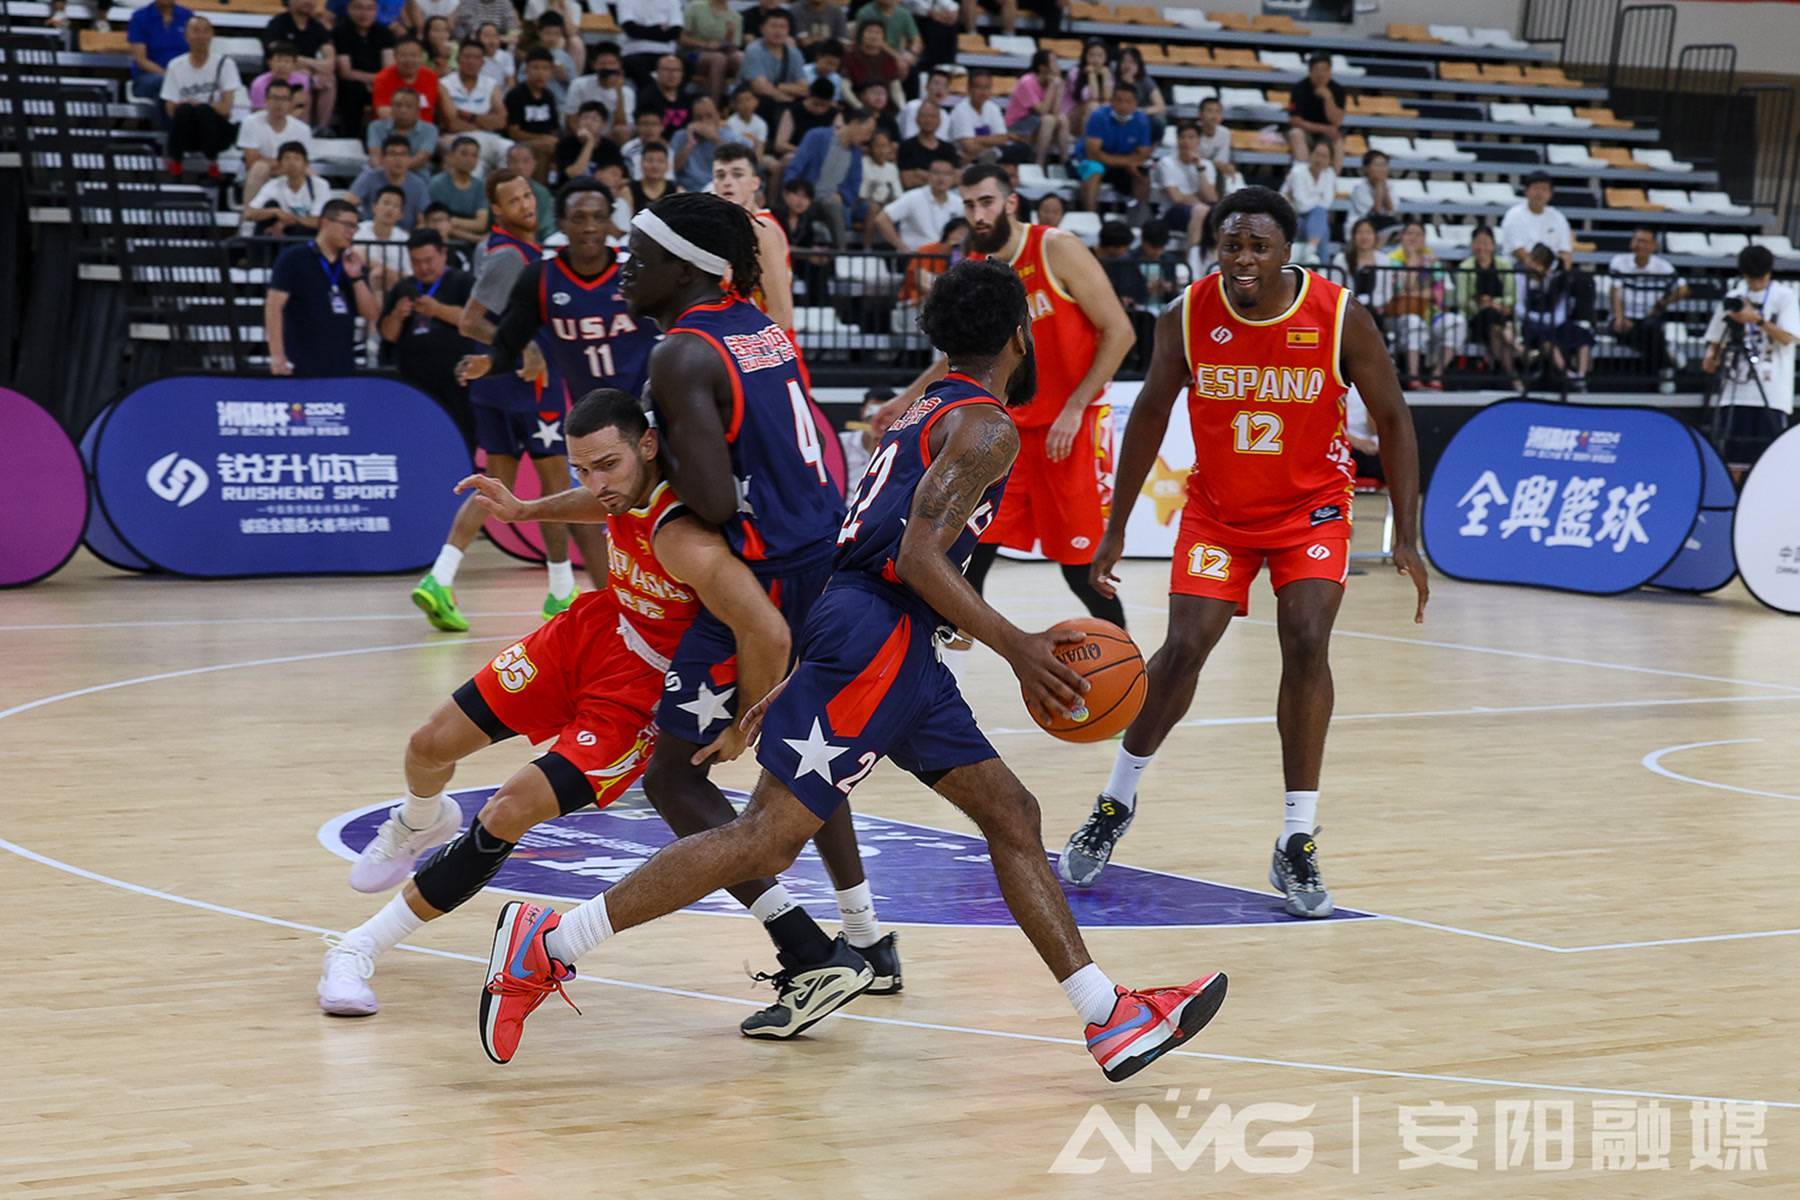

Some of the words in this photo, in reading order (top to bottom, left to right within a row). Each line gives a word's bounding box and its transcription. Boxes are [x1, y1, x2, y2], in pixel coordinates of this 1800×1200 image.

[551, 313, 637, 340] USA
[583, 343, 616, 378] 11
[1196, 363, 1325, 403] ESPANA
[787, 378, 829, 486] 4
[1231, 411, 1283, 454] 12
[217, 452, 399, 484] 锐升体育
[221, 485, 325, 501] RUISHENG
[332, 484, 399, 500] SPORT
[1188, 543, 1233, 581] 12
[491, 642, 538, 693] 55
[1055, 642, 1102, 665] QUAN
